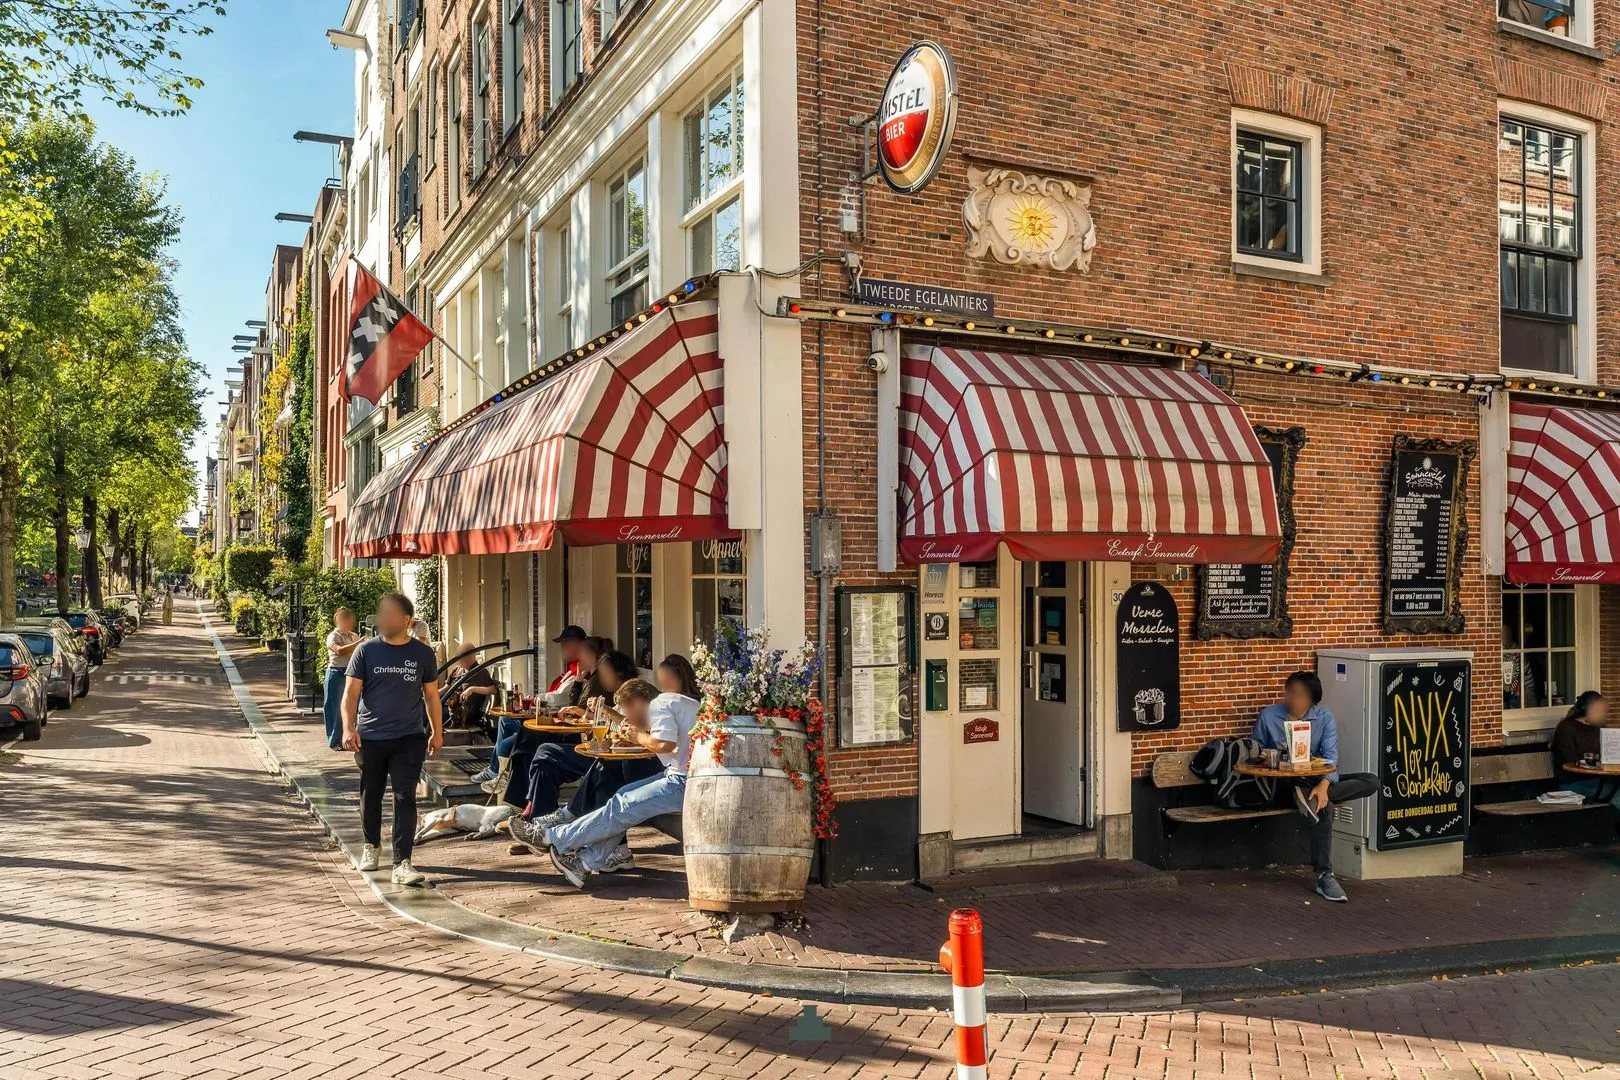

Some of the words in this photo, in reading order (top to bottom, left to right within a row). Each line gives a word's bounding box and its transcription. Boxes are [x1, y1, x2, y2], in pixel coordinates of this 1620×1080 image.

[885, 121, 905, 142] BIER
[863, 283, 910, 302] TWEEDE
[916, 290, 988, 312] EGELANTIERS
[1405, 470, 1447, 484] Sonneveld
[617, 524, 683, 541] Sonneveld
[919, 541, 961, 559] Sonneveld
[1144, 541, 1199, 558] Sonneveld
[1551, 567, 1606, 581] Sonneveld
[1131, 605, 1164, 618] Verse
[1121, 619, 1175, 635] Mosselen
[373, 665, 417, 675] Christopher
[404, 660, 417, 668] Go!
[403, 674, 417, 682] Go!
[1394, 690, 1453, 761] NYX
[1387, 808, 1404, 820] IEDERE
[1404, 805, 1434, 817] DONDERDAG
[1434, 804, 1447, 814] CLUB
[1447, 802, 1458, 812] NYX
